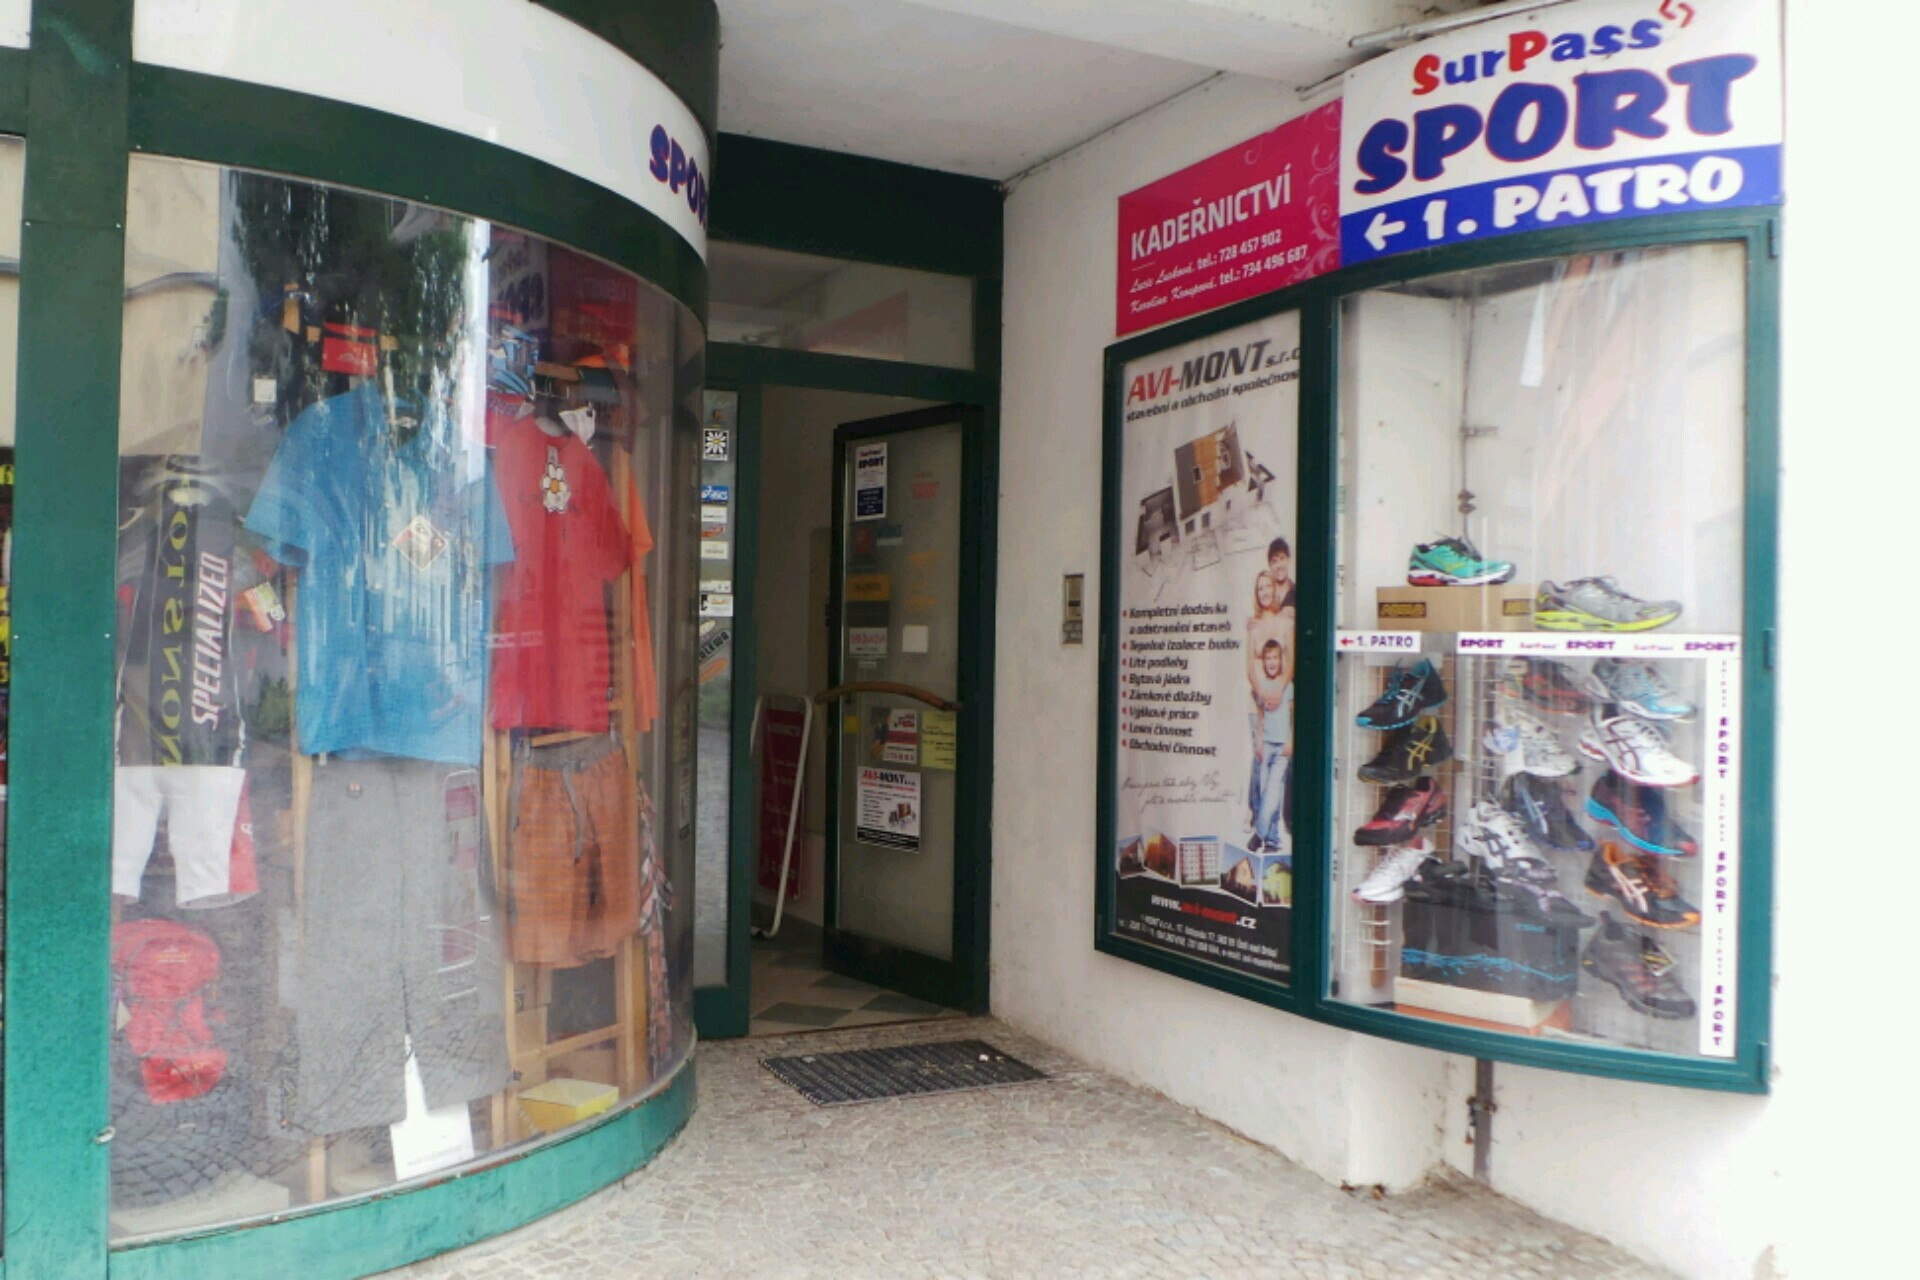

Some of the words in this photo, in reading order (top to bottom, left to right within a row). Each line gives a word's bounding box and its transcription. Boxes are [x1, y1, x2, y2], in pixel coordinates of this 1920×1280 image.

[1413, 19, 1663, 96] SurPass
[1354, 53, 1757, 195] SPORT
[1131, 163, 1291, 261] KADEŘNICTVÍ
[1422, 199, 1478, 241] 1.
[1493, 157, 1743, 229] PATRO
[1240, 236, 1259, 254] 457
[1261, 228, 1282, 248] 902
[1242, 260, 1261, 279] 734
[1126, 339, 1271, 405] AVI-MONT
[1126, 403, 1170, 423] stavební
[1181, 383, 1231, 408] obchodní
[191, 552, 229, 731] SPECIALIZED
[1371, 635, 1413, 648] PATRO
[1460, 638, 1504, 649] SPORT
[1566, 640, 1615, 650] SPORT
[1684, 641, 1737, 652] SPORT
[1173, 742, 1217, 757] činnost
